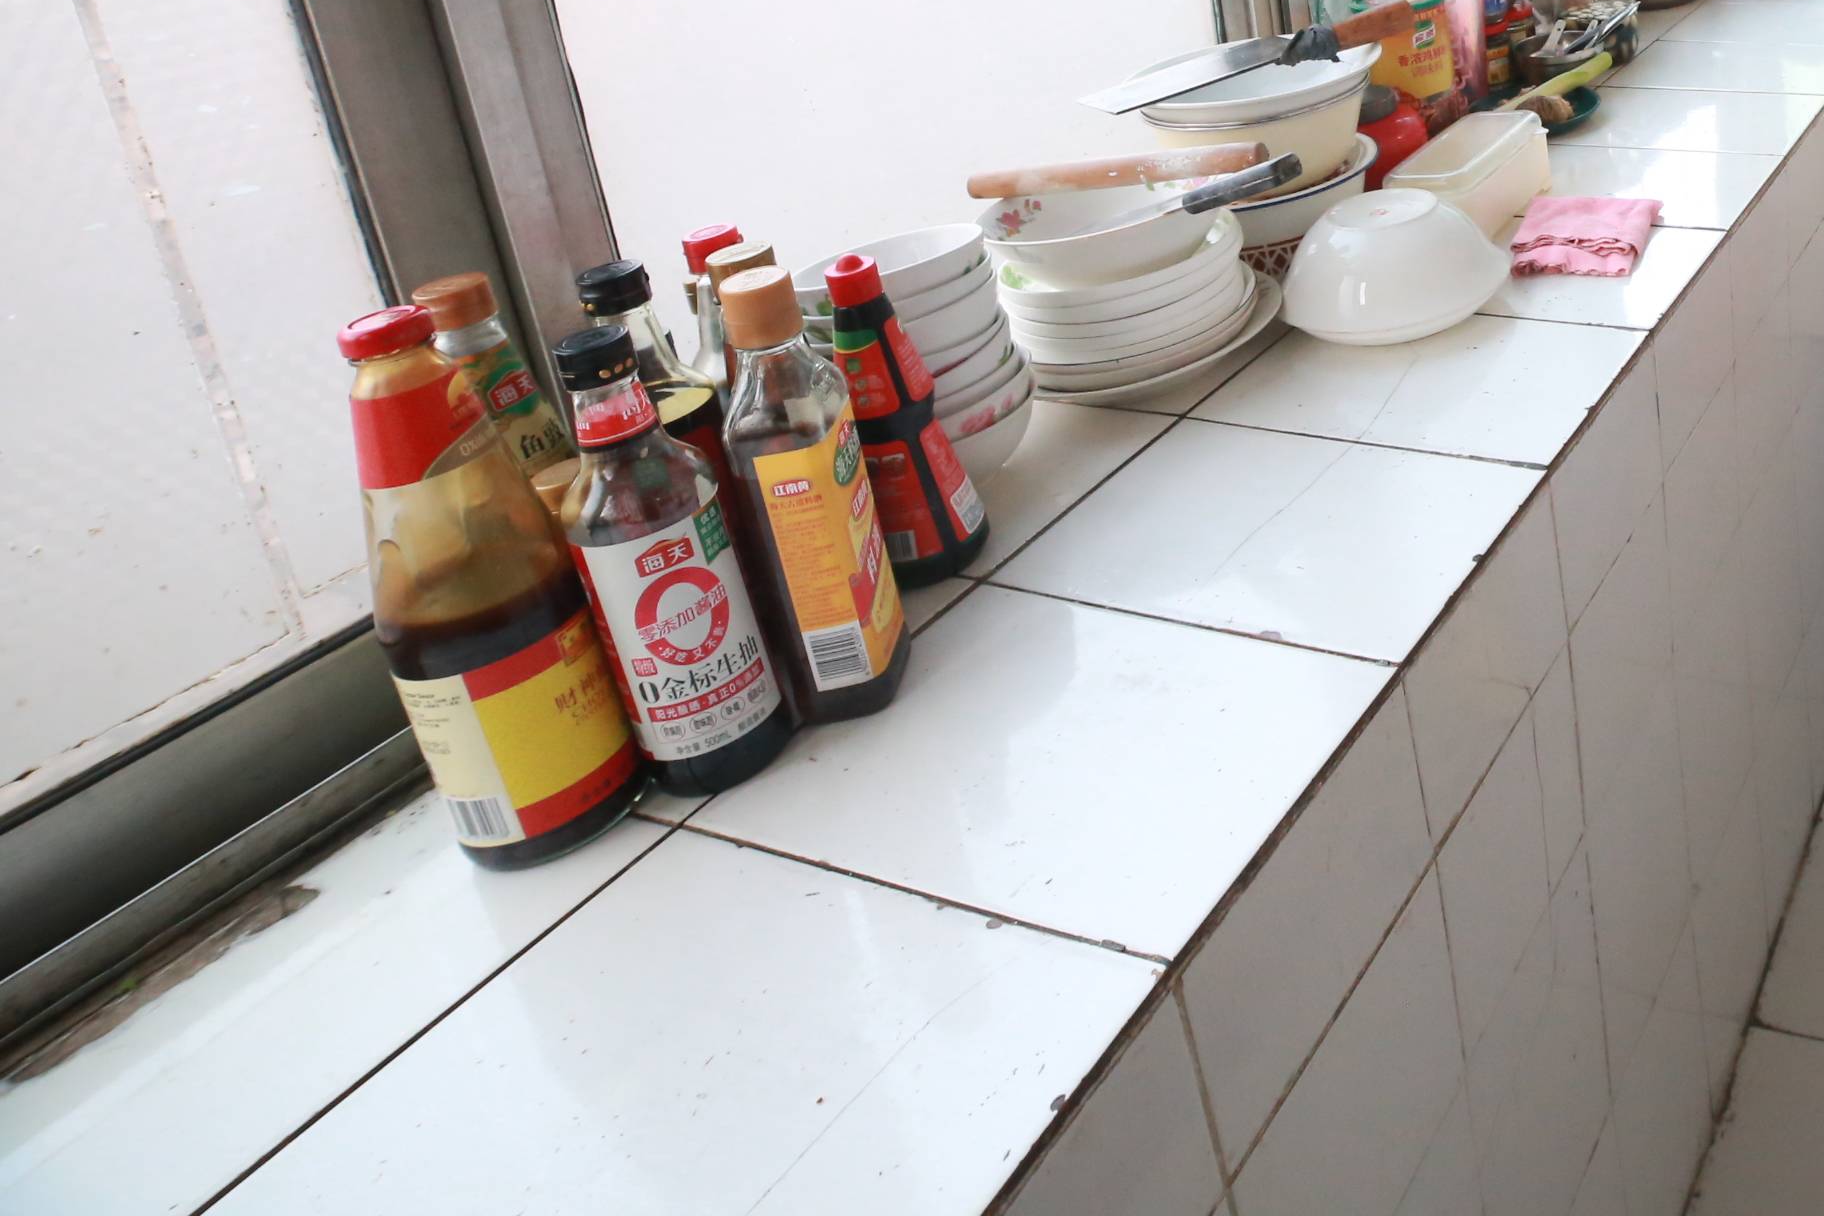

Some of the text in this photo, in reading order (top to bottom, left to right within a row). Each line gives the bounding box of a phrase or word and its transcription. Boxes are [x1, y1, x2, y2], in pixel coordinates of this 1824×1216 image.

[643, 541, 689, 574] 海天
[638, 583, 727, 642] 零添加酱油
[638, 634, 759, 705] 0金标生抽
